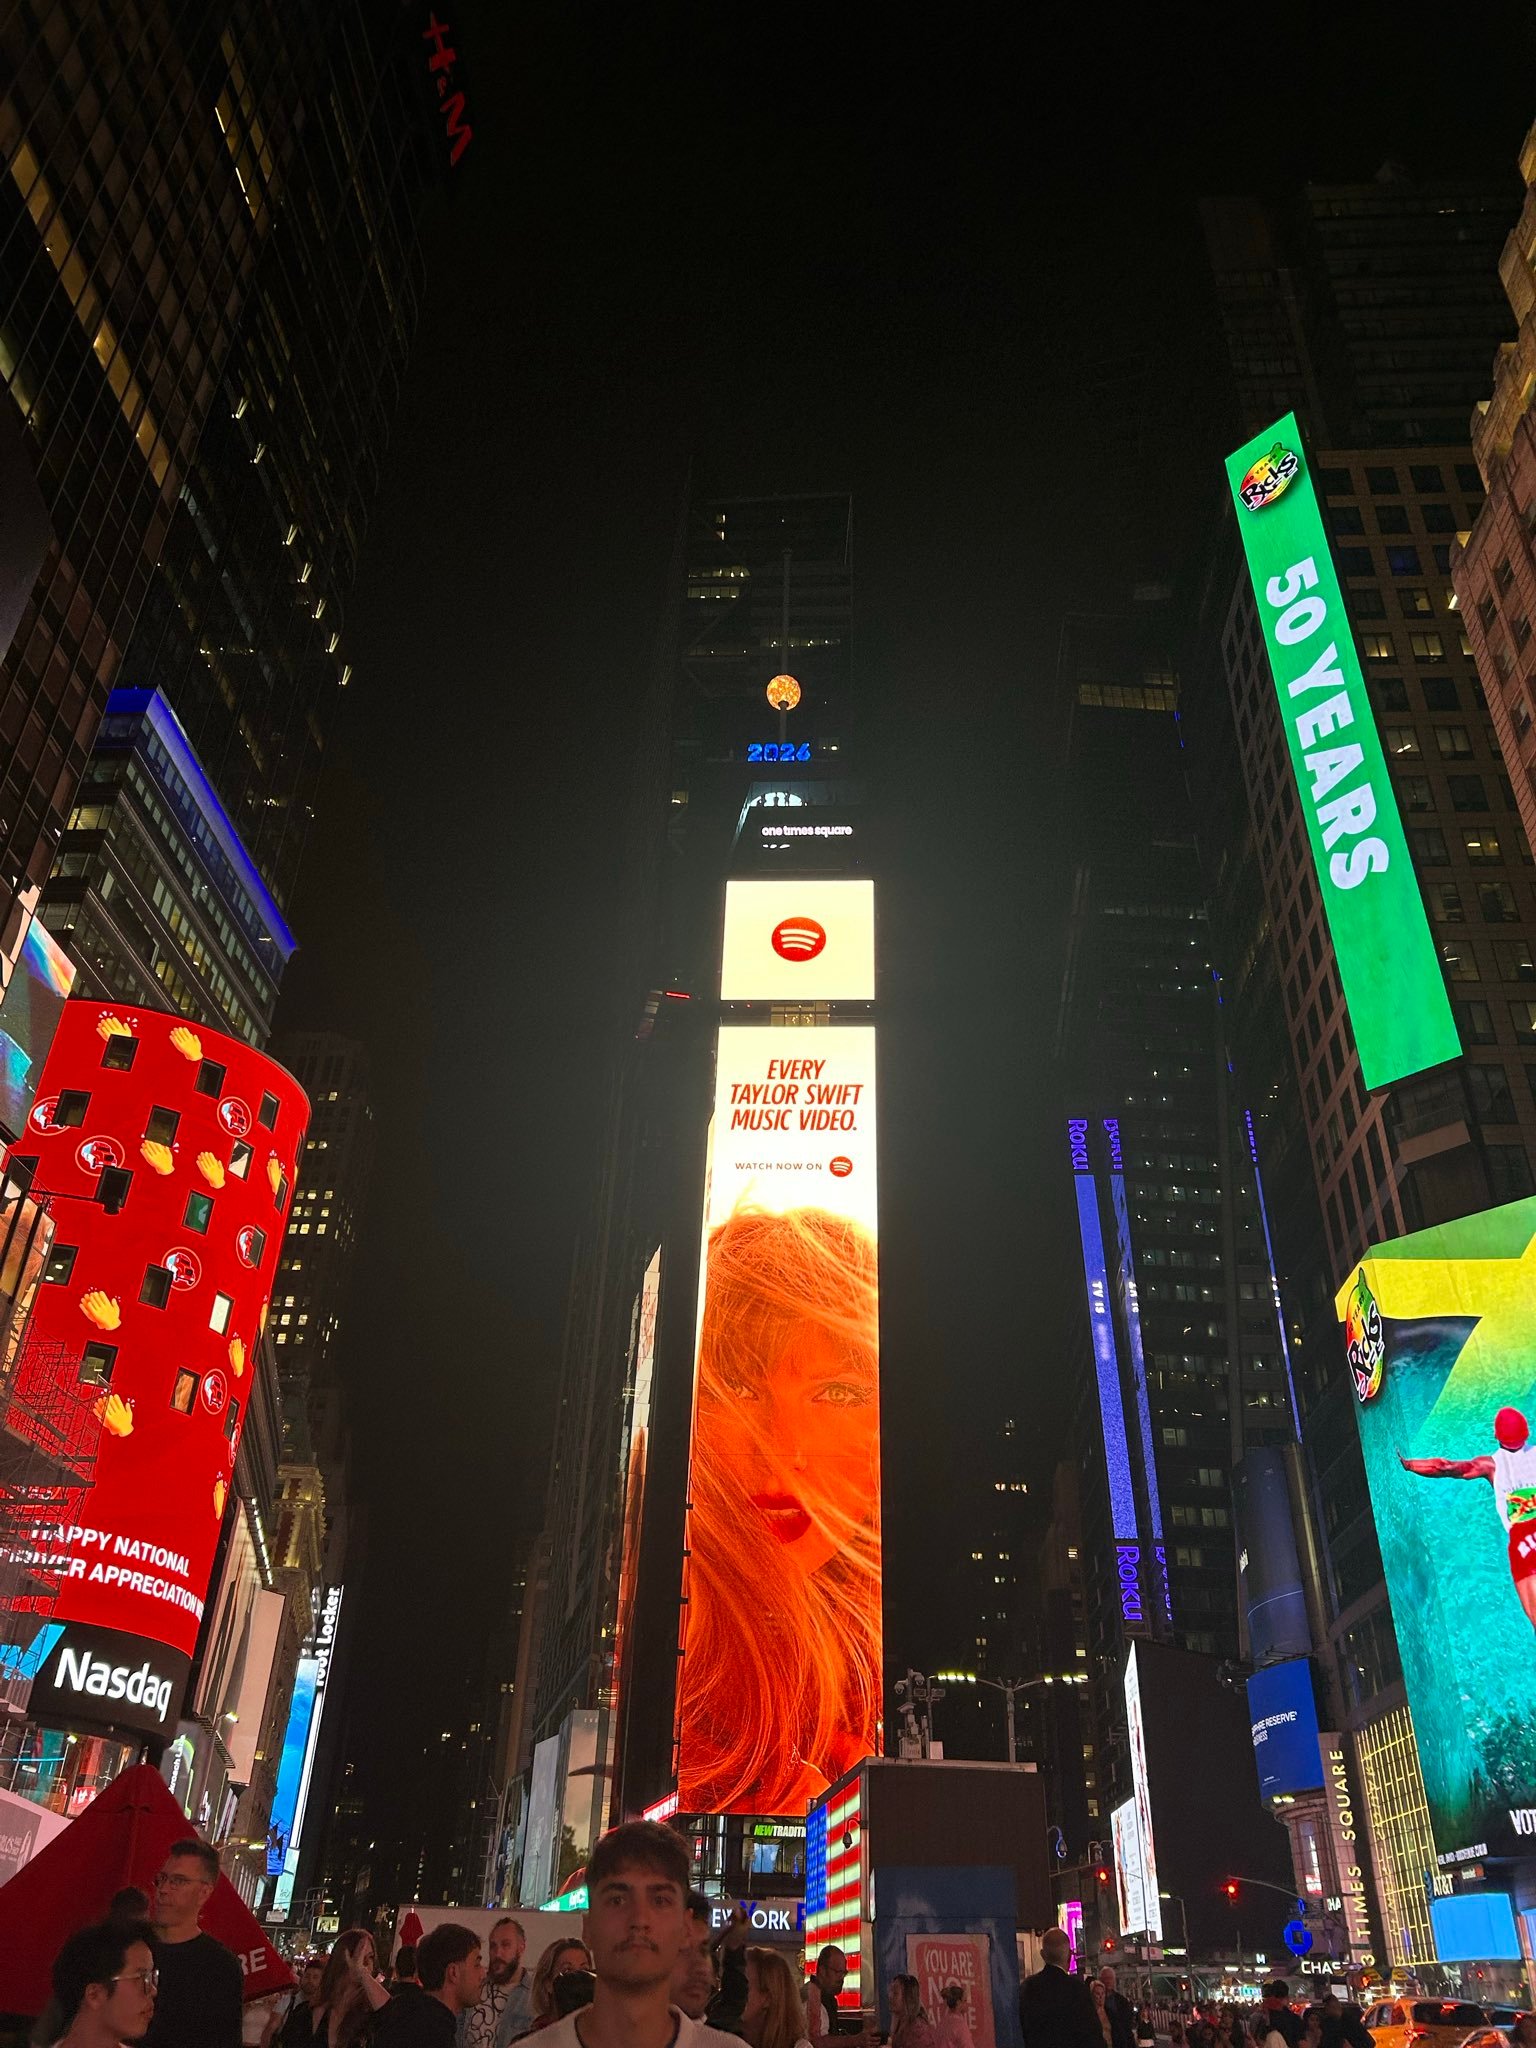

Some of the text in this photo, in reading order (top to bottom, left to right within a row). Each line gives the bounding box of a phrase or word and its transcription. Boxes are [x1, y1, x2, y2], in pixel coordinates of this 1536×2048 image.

[1266, 556, 1327, 646] 50
[747, 742, 811, 762] 2026
[1288, 641, 1390, 890] YEARS
[761, 825, 853, 838] one times square
[767, 1059, 826, 1080] EVERY
[730, 1083, 864, 1105] TAYLOR SWIFT
[730, 1109, 858, 1131] MUSIC VIDEO.
[735, 1162, 823, 1171] WATCH NOW ON
[113, 1535, 190, 1578] NATIONAL
[88, 1562, 197, 1614] APPRECIATION
[316, 1587, 341, 1644] Locker
[53, 1647, 173, 1723] Nasdaq
[1329, 1749, 1356, 1842] SQUARE
[1433, 1873, 1454, 1896] AT&T
[1347, 1865, 1371, 1938] TIMES
[711, 1908, 734, 1929] EW
[924, 1948, 976, 1979] YOU ARE
[1301, 1960, 1350, 1975] CHAS
